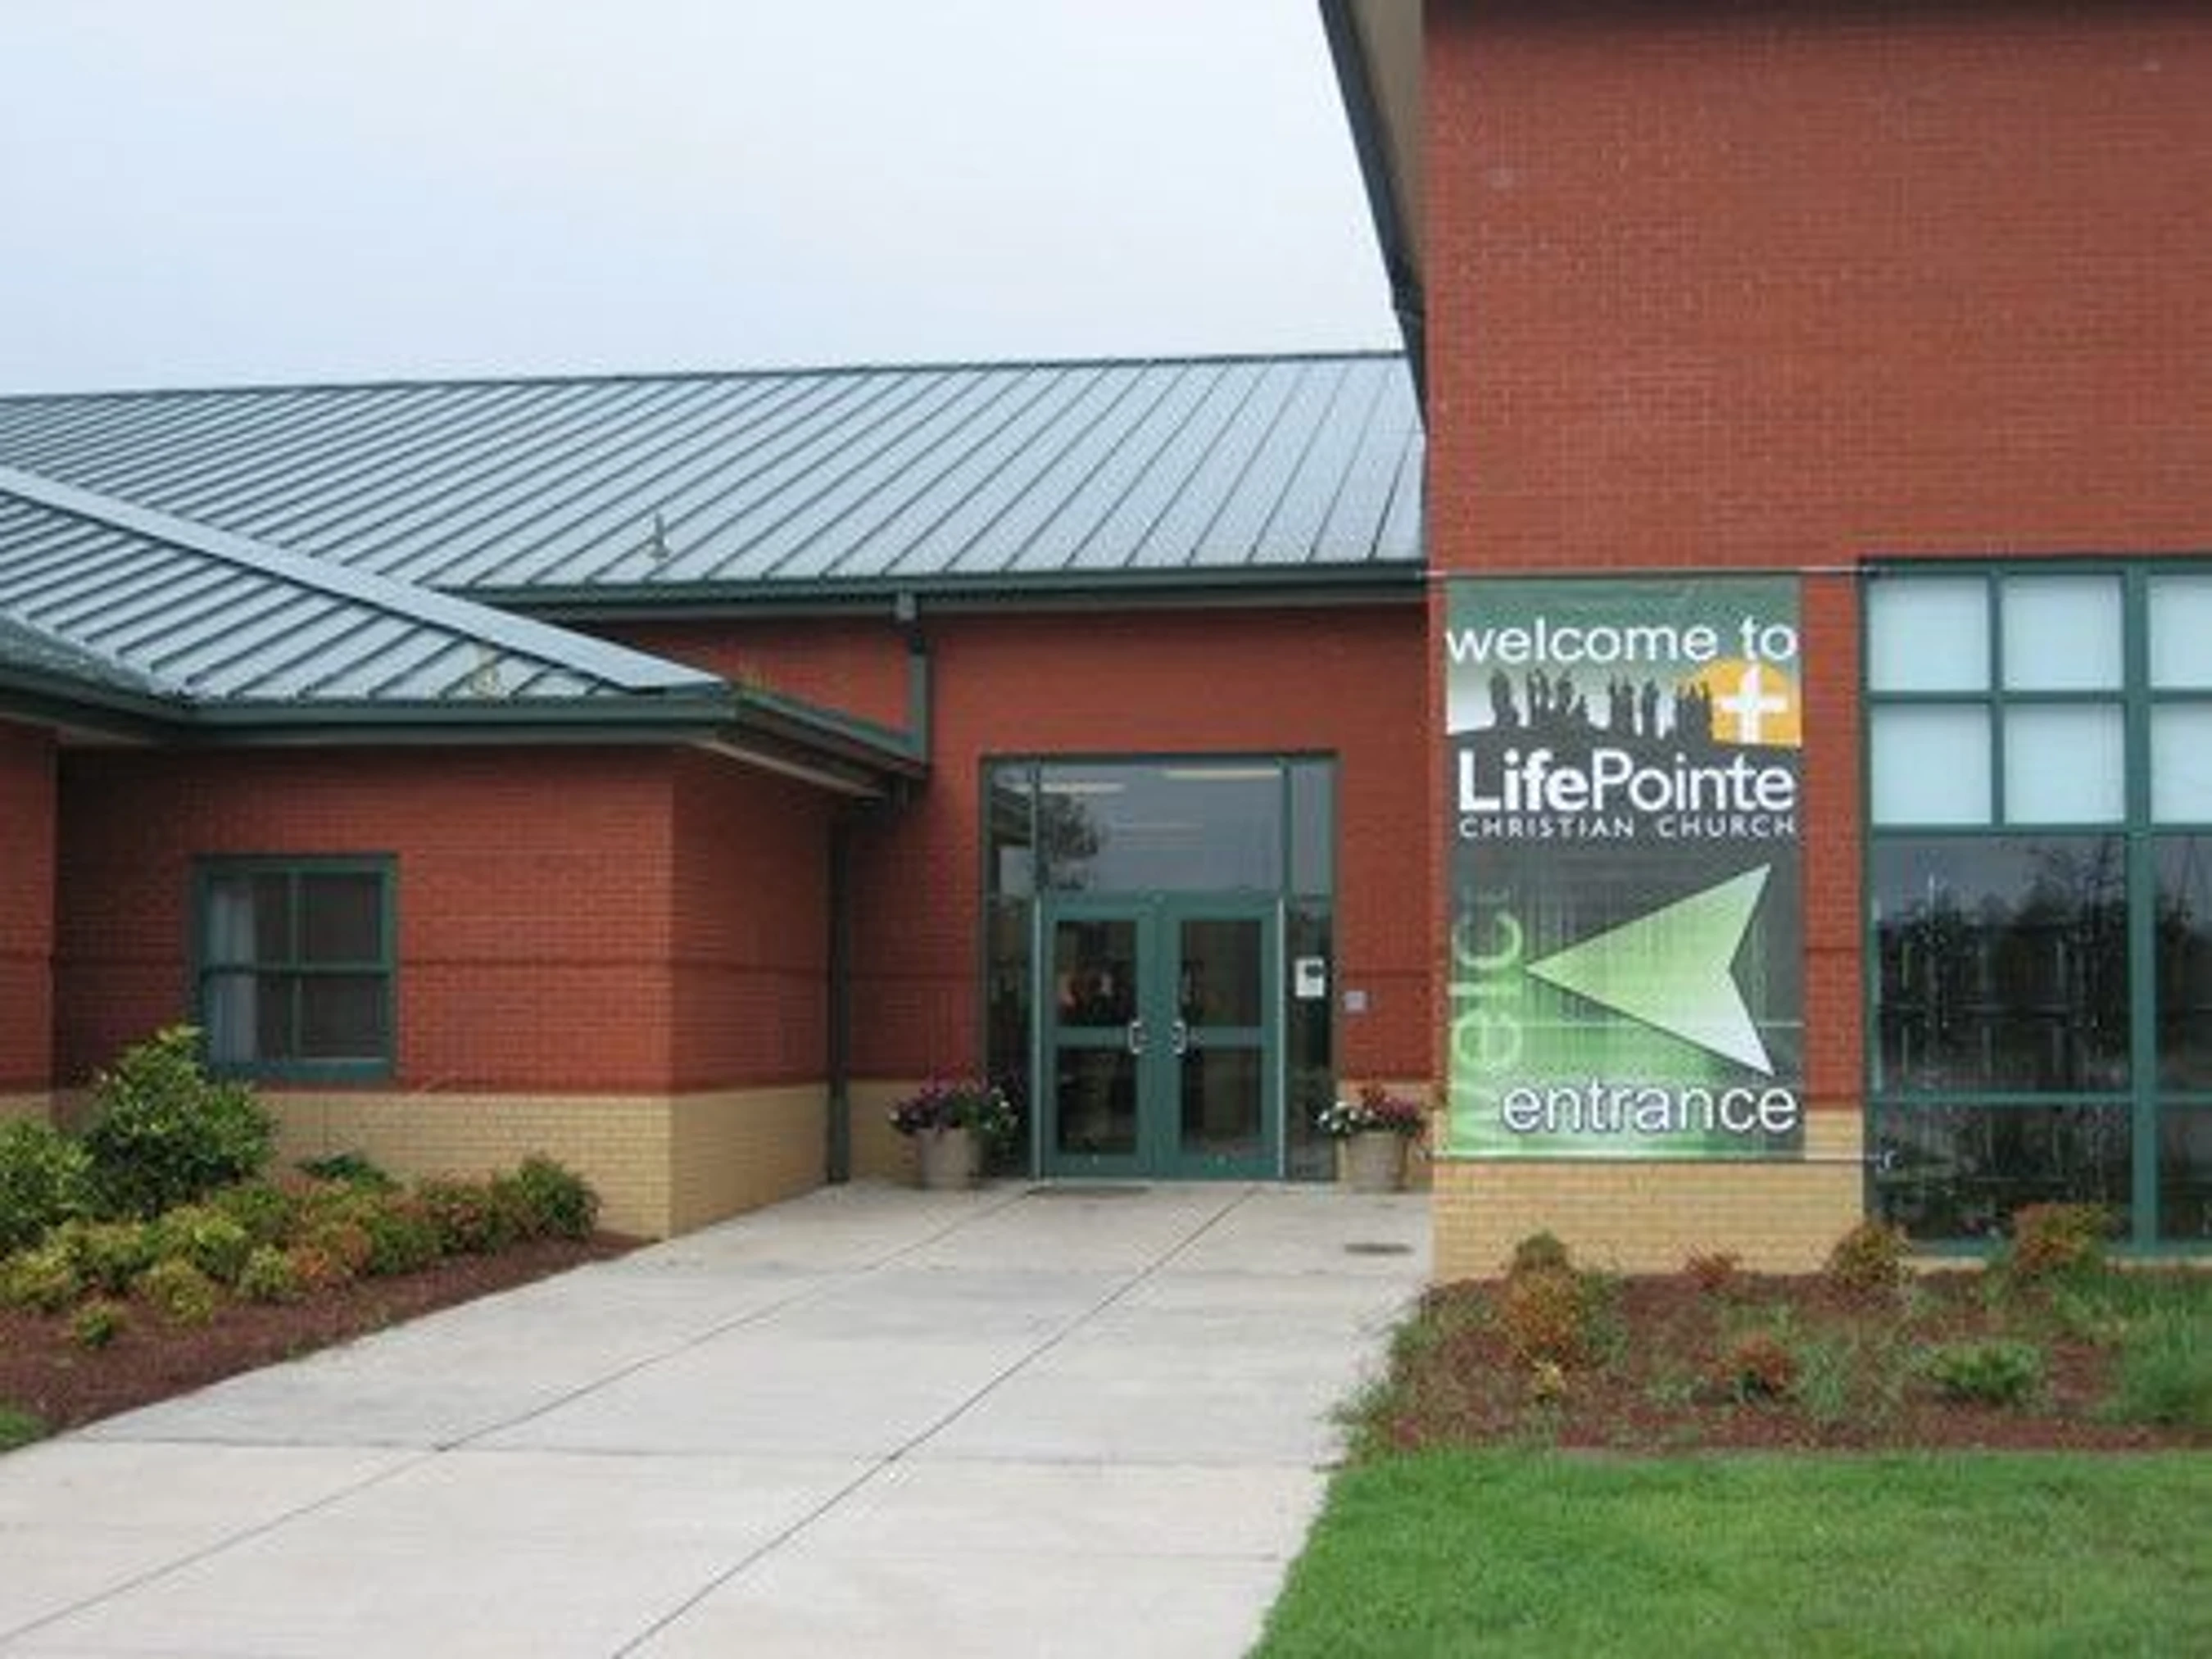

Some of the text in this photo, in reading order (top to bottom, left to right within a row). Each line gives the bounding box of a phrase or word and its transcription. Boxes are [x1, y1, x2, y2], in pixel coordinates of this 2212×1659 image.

[1445, 615, 1799, 663] welcome to
[1458, 749, 1795, 811] LifePointe
[1459, 817, 1795, 838] CHRISTIAN CHURCH
[1503, 1077, 1797, 1131] entrance
